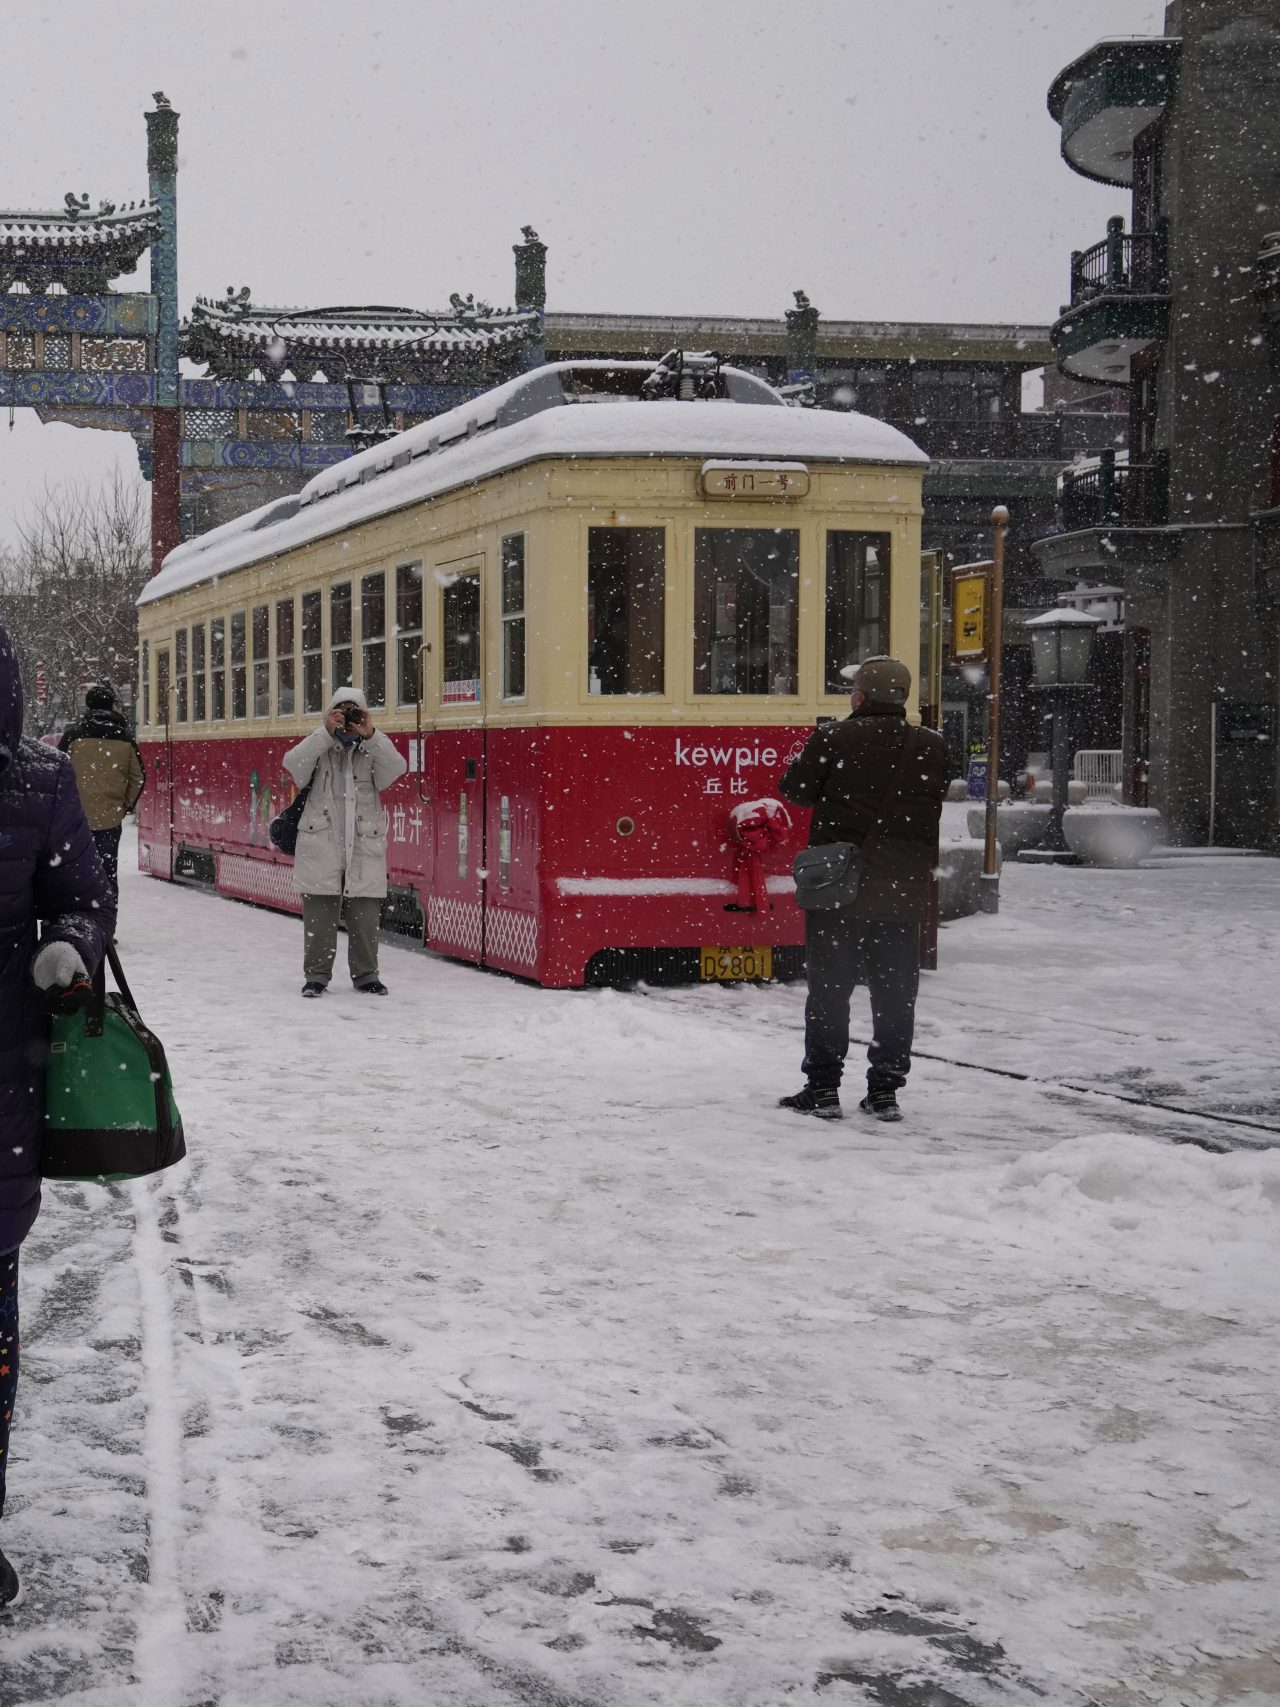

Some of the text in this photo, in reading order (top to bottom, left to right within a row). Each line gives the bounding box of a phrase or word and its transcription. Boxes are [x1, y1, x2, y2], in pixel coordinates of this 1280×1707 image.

[724, 473, 790, 491] 前门一号
[675, 738, 778, 774] kewpie
[703, 777, 749, 794] 丘比
[704, 956, 765, 977] D9801
